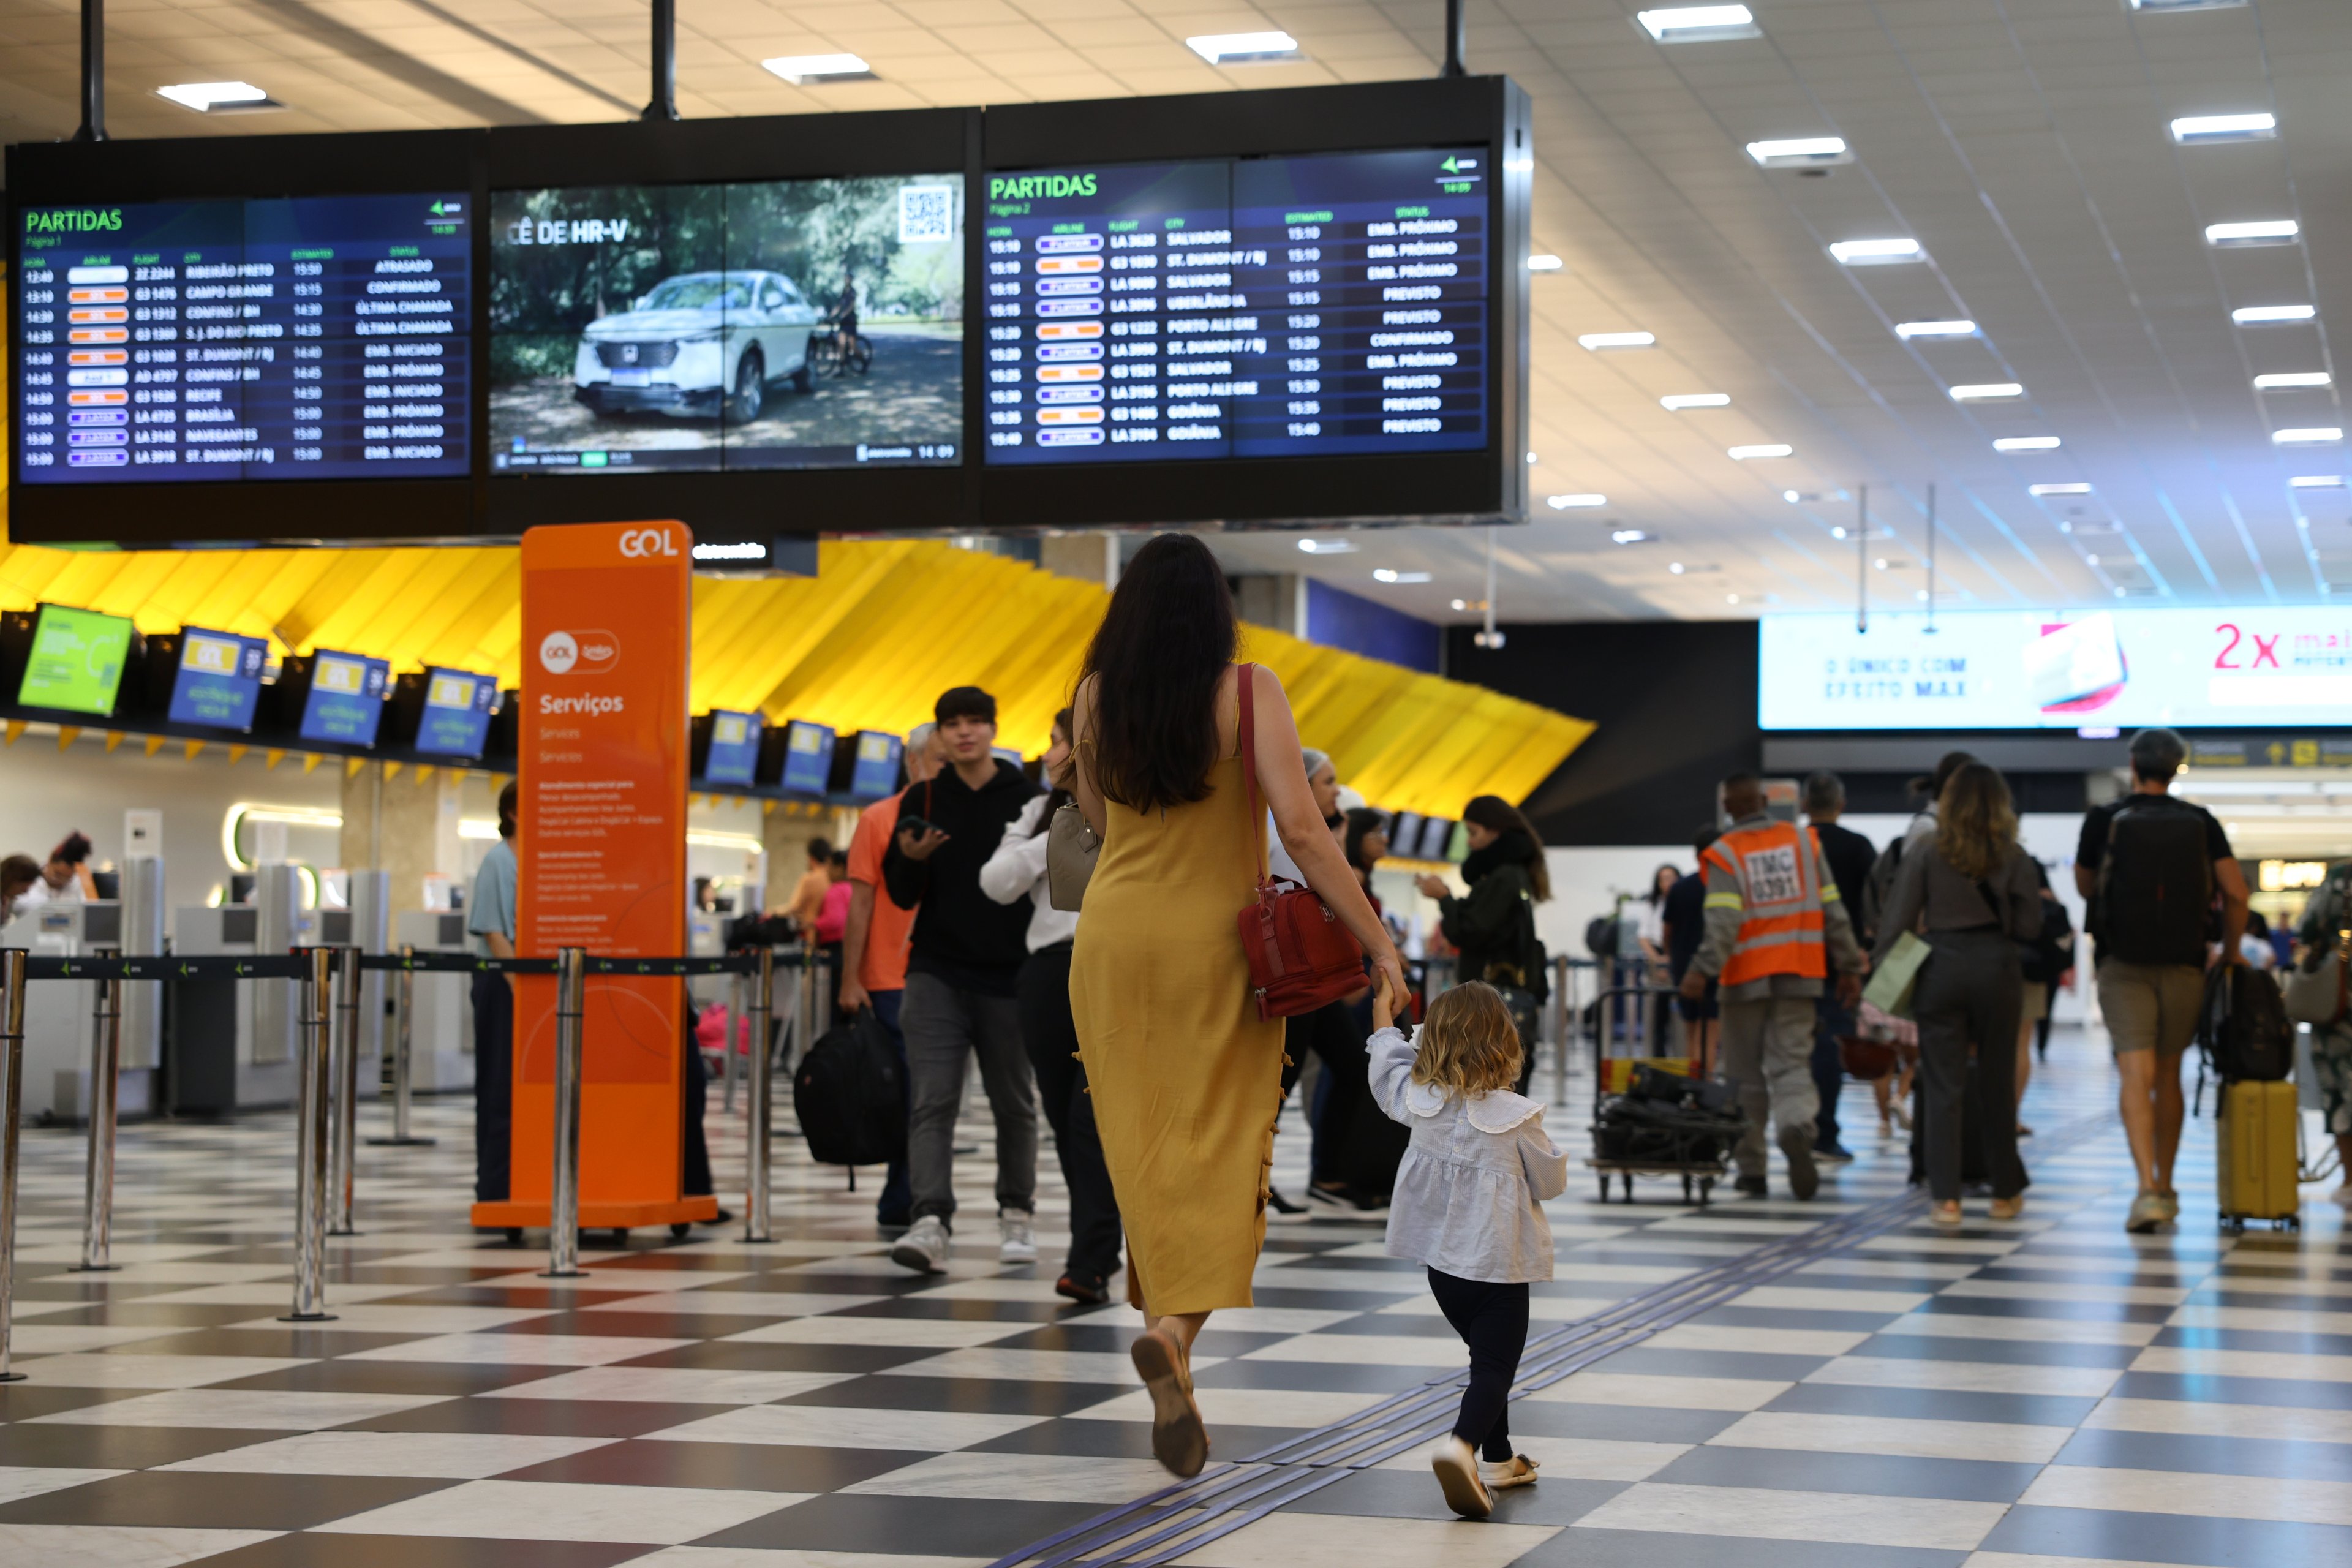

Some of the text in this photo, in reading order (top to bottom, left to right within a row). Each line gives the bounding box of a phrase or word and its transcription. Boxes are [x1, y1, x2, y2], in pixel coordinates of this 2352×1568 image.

[990, 173, 1097, 200] PARTIDAS
[989, 202, 1030, 217] Página 2
[1109, 221, 1139, 232] FLIGHT
[1164, 217, 1185, 230] CITY
[1395, 205, 1430, 219] STATUS
[26, 208, 123, 233] PARTIDAS
[537, 220, 568, 244] DE
[571, 218, 628, 244] HR-V
[1167, 230, 1231, 246] SALVADOR
[1398, 219, 1457, 235] PRÓXIMO
[26, 236, 55, 249] Página
[1186, 251, 1244, 266] DUMONT
[1398, 240, 1457, 257] PRÓXIMO
[186, 263, 236, 279] RIBEIRÃO
[237, 263, 274, 277] PRETO
[375, 259, 433, 273] ATRASADO
[1167, 273, 1231, 288] SALVADOR
[1399, 262, 1457, 278] PRÓXIMO
[186, 285, 226, 299] CAMPO
[226, 284, 273, 298] GRANDE
[368, 279, 441, 294] CONFIRMADO
[1384, 285, 1441, 301] PREVISTO
[186, 306, 235, 319] CONFINS
[356, 301, 397, 314] ÚLTIMA
[397, 300, 453, 313] CHAMADA
[246, 324, 283, 337] PRETO
[356, 321, 397, 335] ÚLTIMA
[397, 320, 453, 334] CHAMADA
[1167, 319, 1210, 333] PORTO
[1210, 317, 1257, 331] ALEGRE
[1383, 309, 1441, 325] PREVISTO
[202, 348, 254, 361] DUMONT
[393, 343, 443, 356] INICIADO
[1186, 339, 1244, 354] DUMONT
[1370, 331, 1453, 347] CONFIRMADO
[186, 368, 235, 382] CONFINS
[391, 363, 443, 377] PRÓXIMO
[1167, 361, 1231, 376] SALVADOR
[1398, 352, 1457, 367] PRÓXIMO
[393, 384, 443, 397] INICIADO
[1167, 383, 1210, 398] PORTO
[1210, 381, 1258, 396] ALEGRE
[1383, 375, 1441, 390] PREVISTO
[391, 403, 443, 417] PRÓXIMO
[1383, 396, 1441, 412] PREVISTO
[186, 428, 258, 442] NAVEGANTES
[391, 423, 443, 438] PRÓXIMO
[1383, 418, 1441, 433] PREVISTO
[202, 448, 254, 462] DUMONT
[393, 445, 443, 458] INICIADO
[918, 444, 955, 459] 14:09
[619, 529, 679, 558] GOL
[545, 646, 573, 660] GOL
[1826, 657, 1966, 674] O ÚNICO COM
[1826, 681, 1966, 698] EFEITO MAX
[540, 692, 624, 717] Serviços
[540, 727, 580, 740] Services
[540, 751, 582, 764] Servicios
[1747, 849, 1793, 876] TMC
